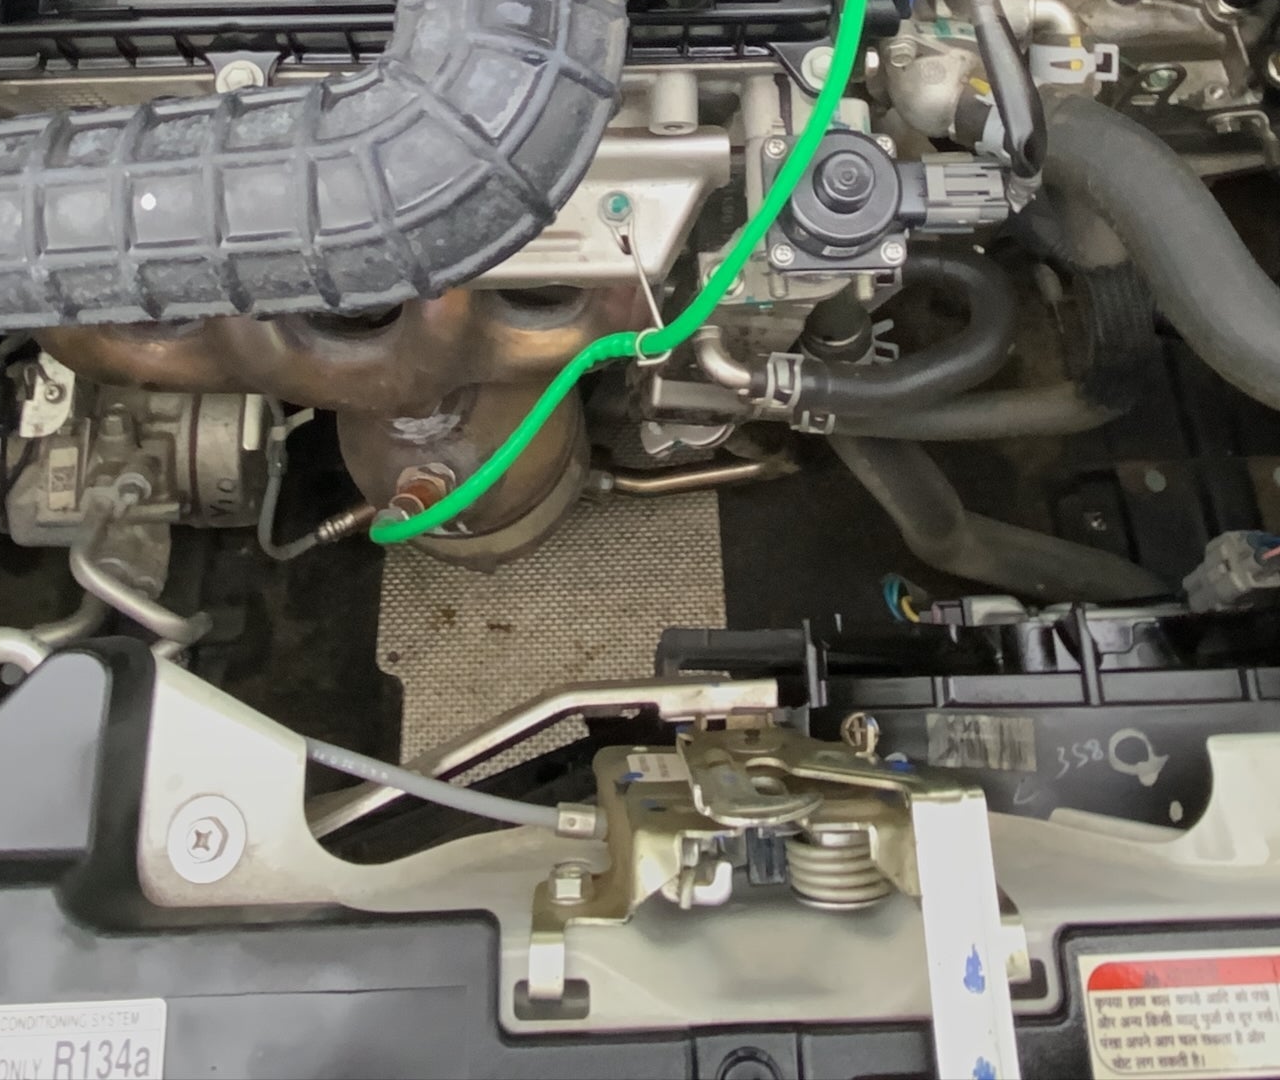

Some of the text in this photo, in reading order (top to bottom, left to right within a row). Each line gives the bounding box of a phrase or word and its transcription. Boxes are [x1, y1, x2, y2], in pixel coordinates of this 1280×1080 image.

[0, 1013, 87, 1031] CONDITIONING
[91, 1011, 141, 1028] SYSTEM
[52, 1038, 151, 1080] R134a
